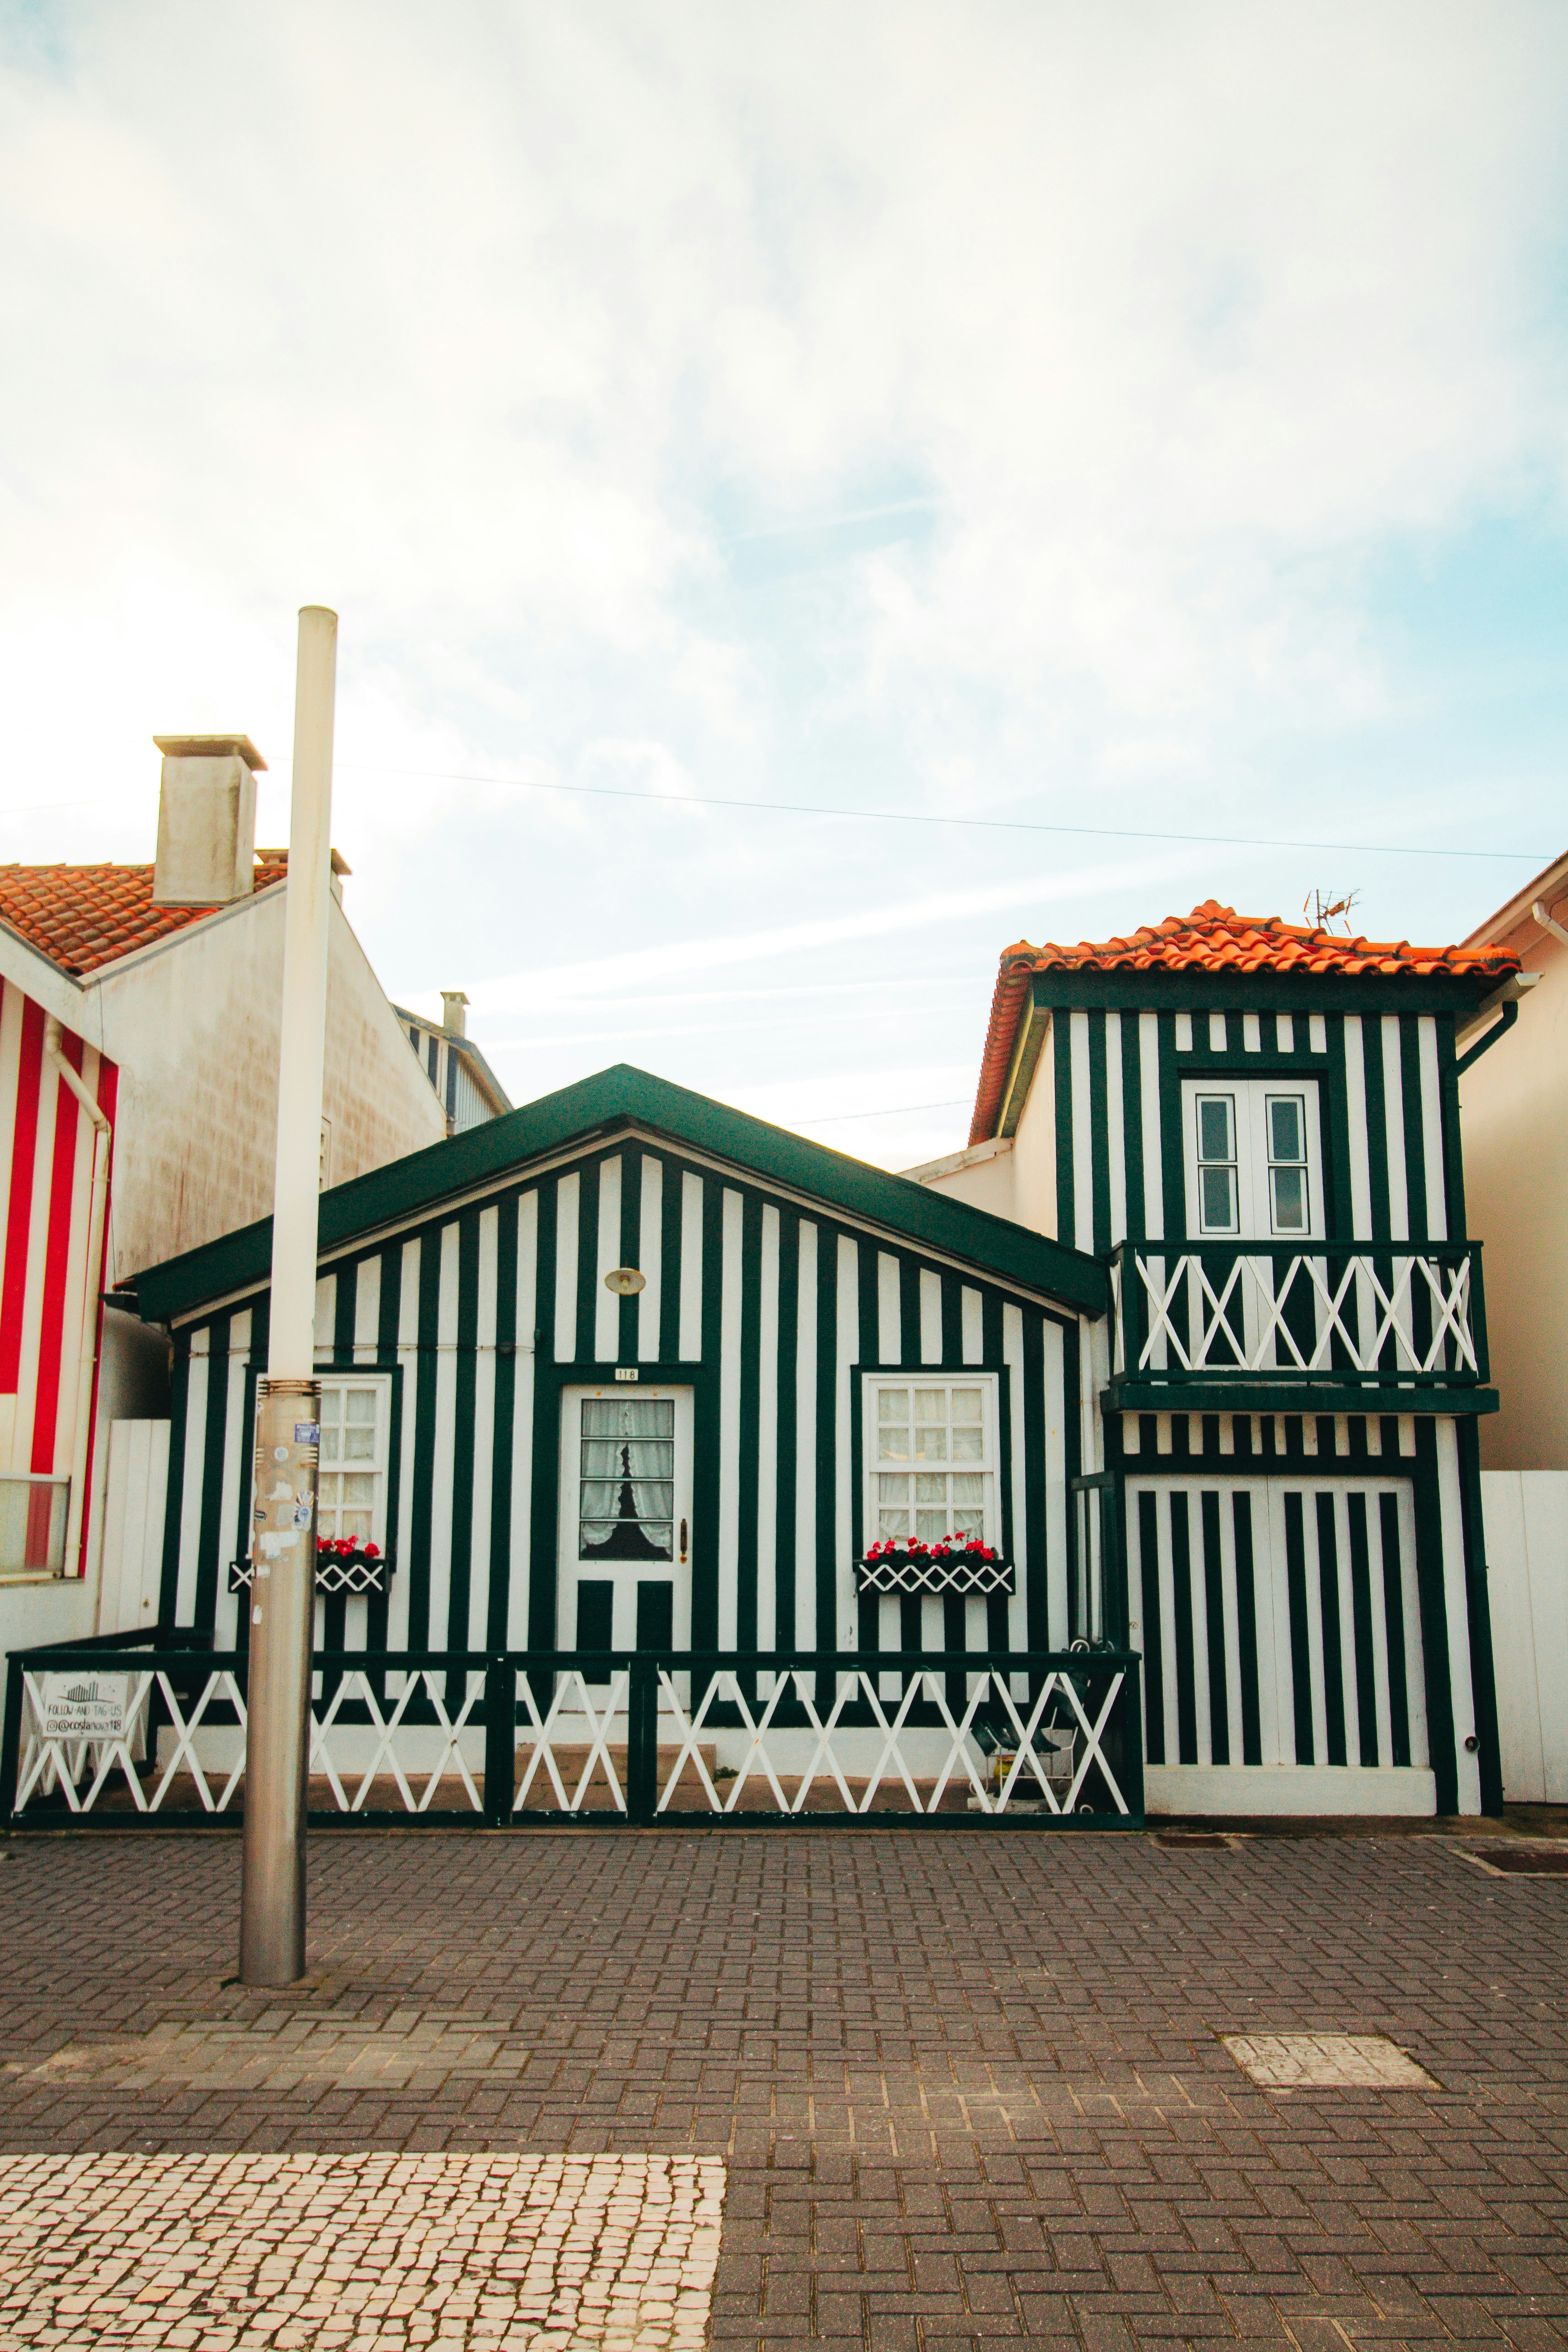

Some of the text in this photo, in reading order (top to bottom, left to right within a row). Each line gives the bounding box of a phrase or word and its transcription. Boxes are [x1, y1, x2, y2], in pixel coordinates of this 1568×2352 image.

[619, 1370, 635, 1379] 118
[48, 1704, 122, 1716] FOLLOW AND TAG US
